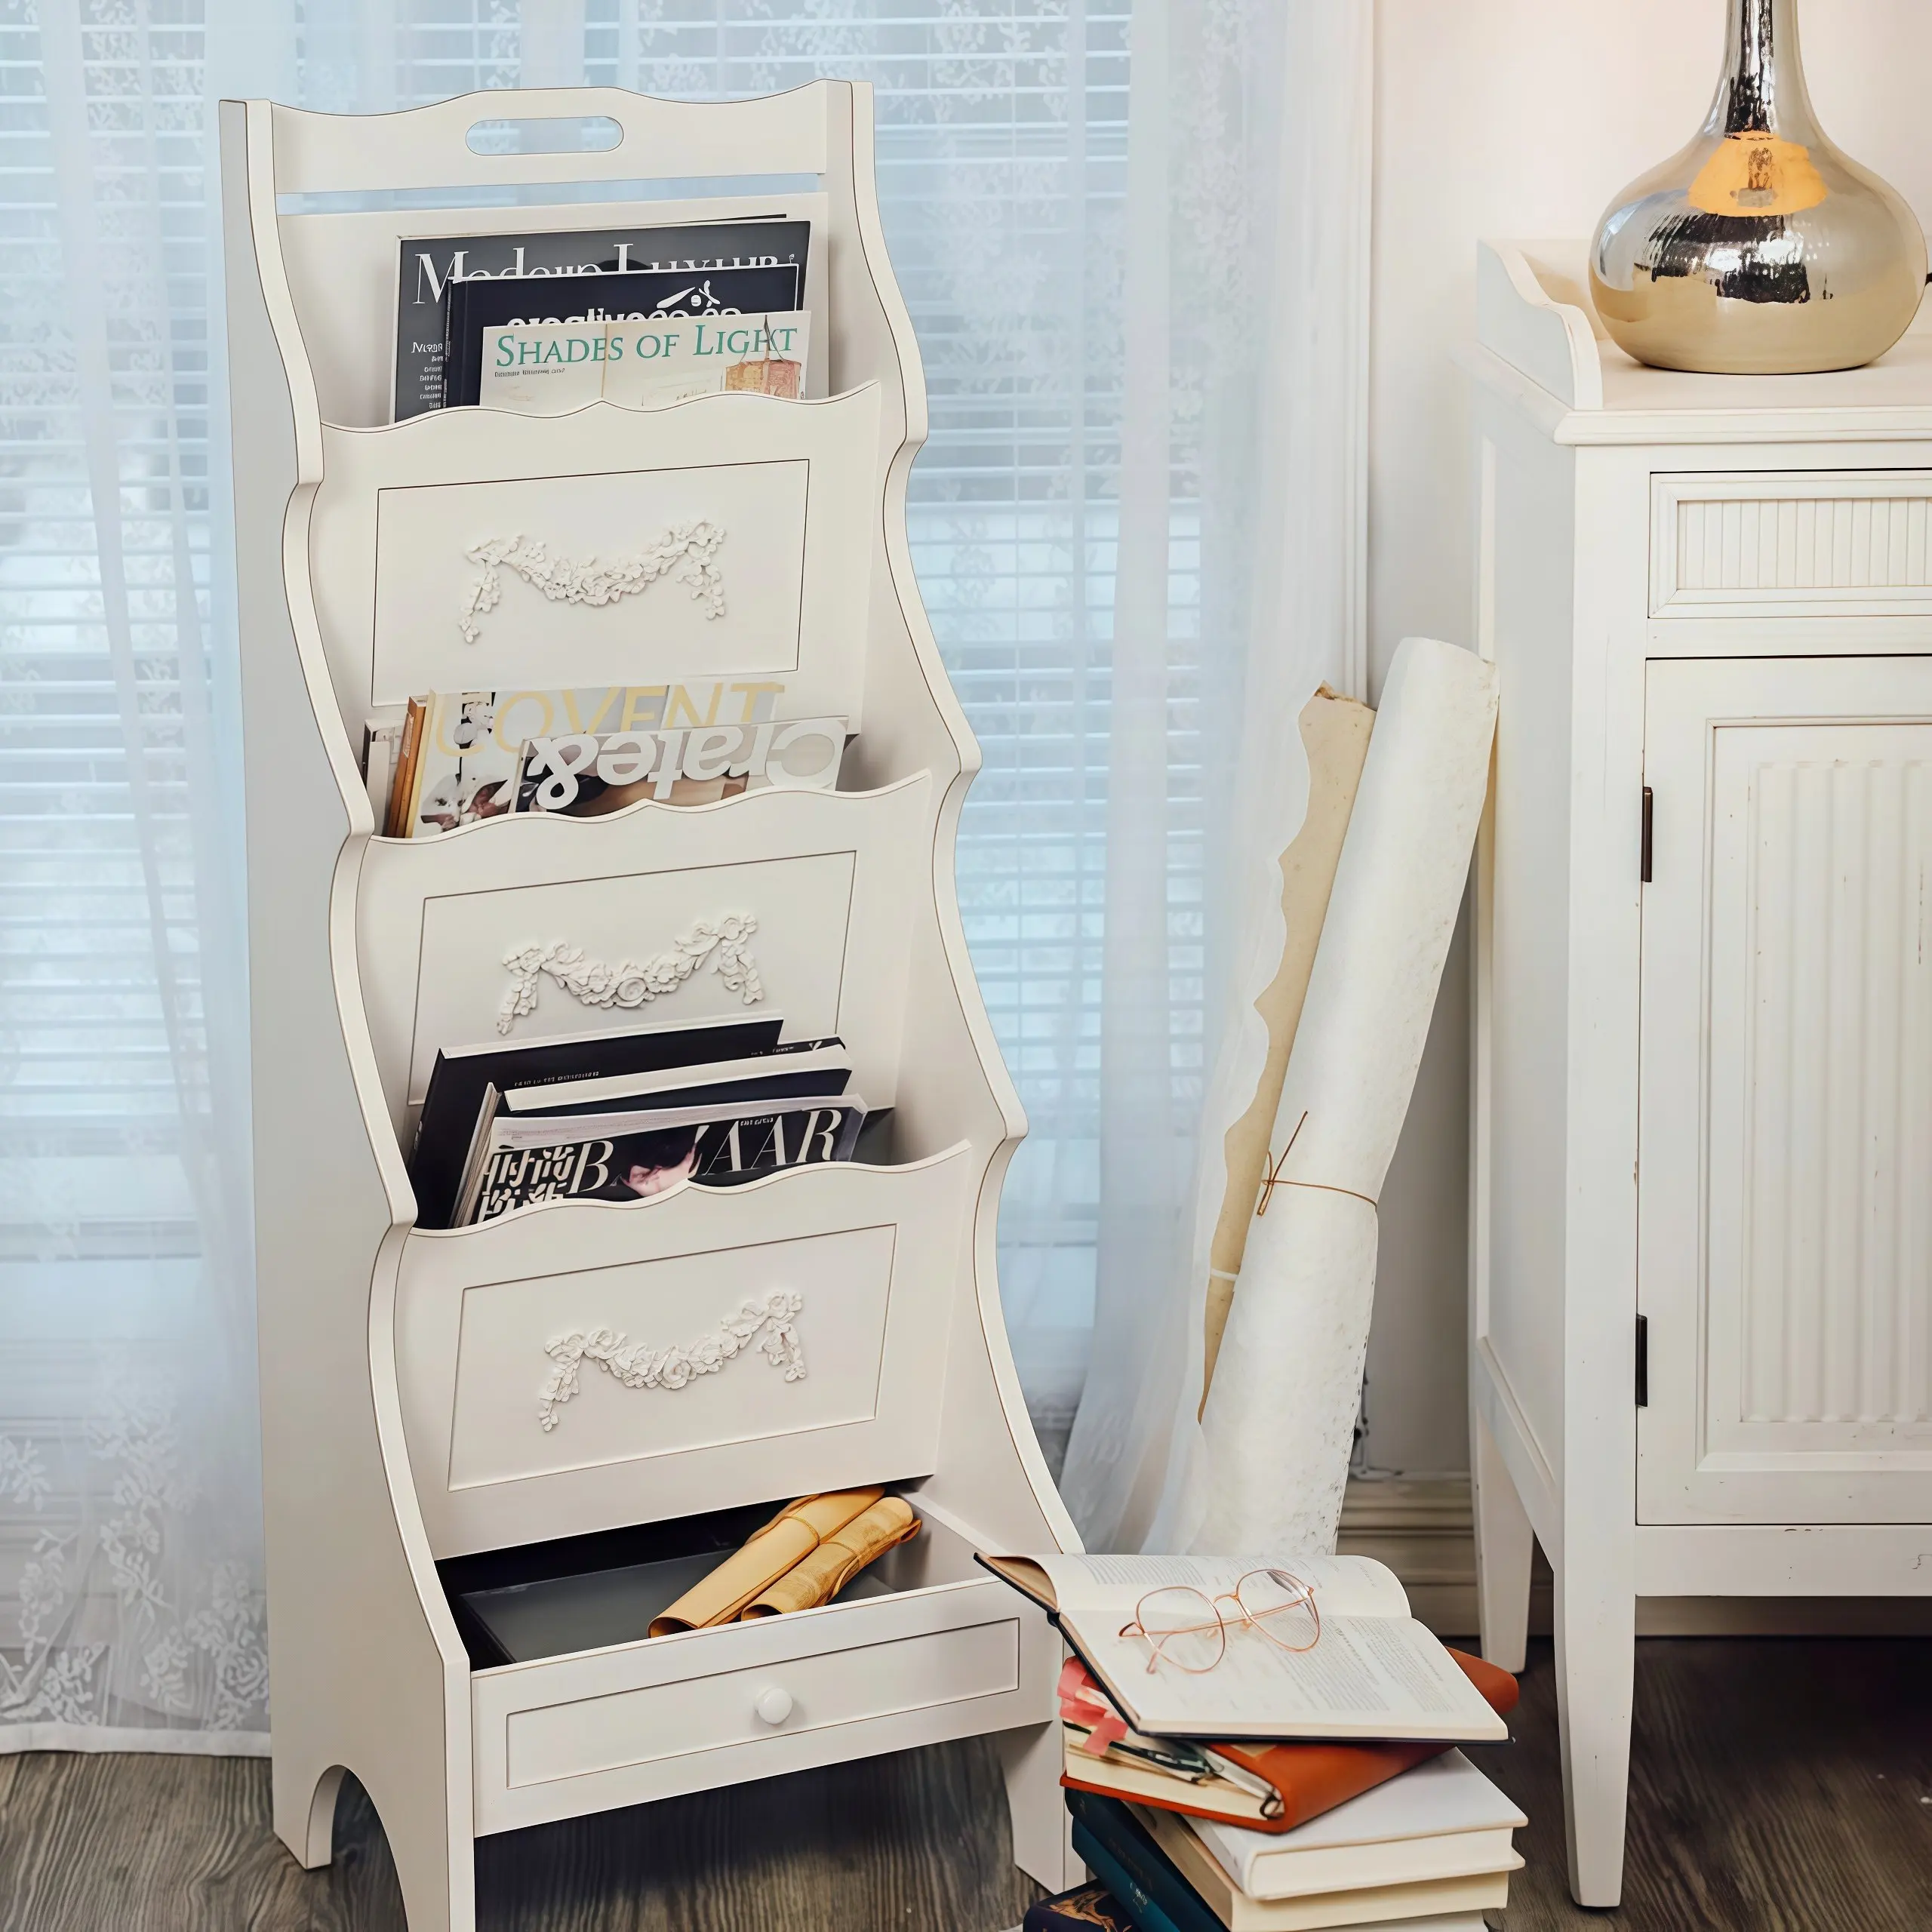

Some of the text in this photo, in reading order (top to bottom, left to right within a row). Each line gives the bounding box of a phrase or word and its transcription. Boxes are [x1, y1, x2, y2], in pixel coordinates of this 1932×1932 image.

[496, 325, 798, 368] SHADES OF LIGHT
